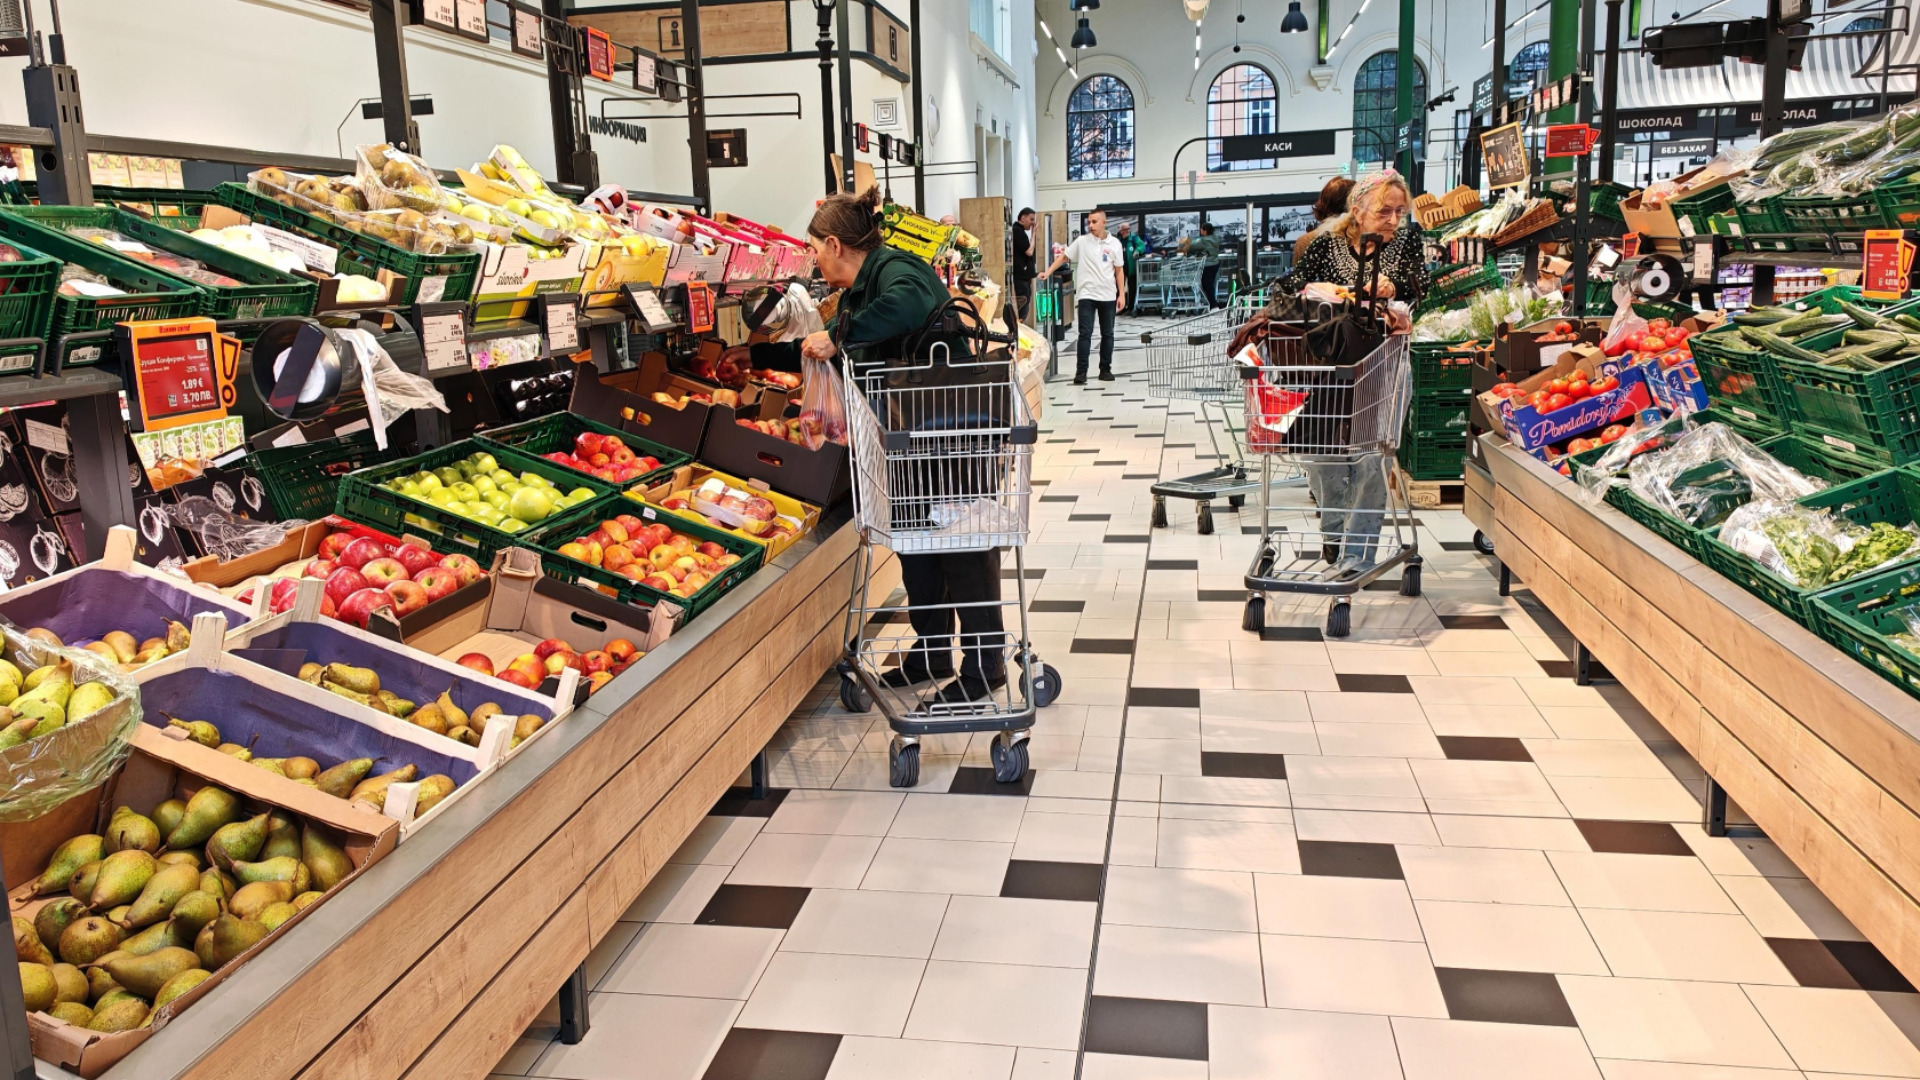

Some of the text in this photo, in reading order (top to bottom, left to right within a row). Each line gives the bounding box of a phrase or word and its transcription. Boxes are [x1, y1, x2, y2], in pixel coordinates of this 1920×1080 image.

[1752, 109, 1817, 122] ШОЛАД
[1618, 116, 1683, 129] ШОКОЛАД
[589, 115, 647, 144] ИНФОРМАЦИЯ
[1264, 142, 1292, 152] КАСИ
[1661, 144, 1707, 154] БЕЗ ЗАХАР
[902, 220, 929, 233] AVOCADOS
[182, 377, 204, 390] 1.89 €
[182, 392, 199, 404] 3.70
[1529, 405, 1611, 447] Pomidory
